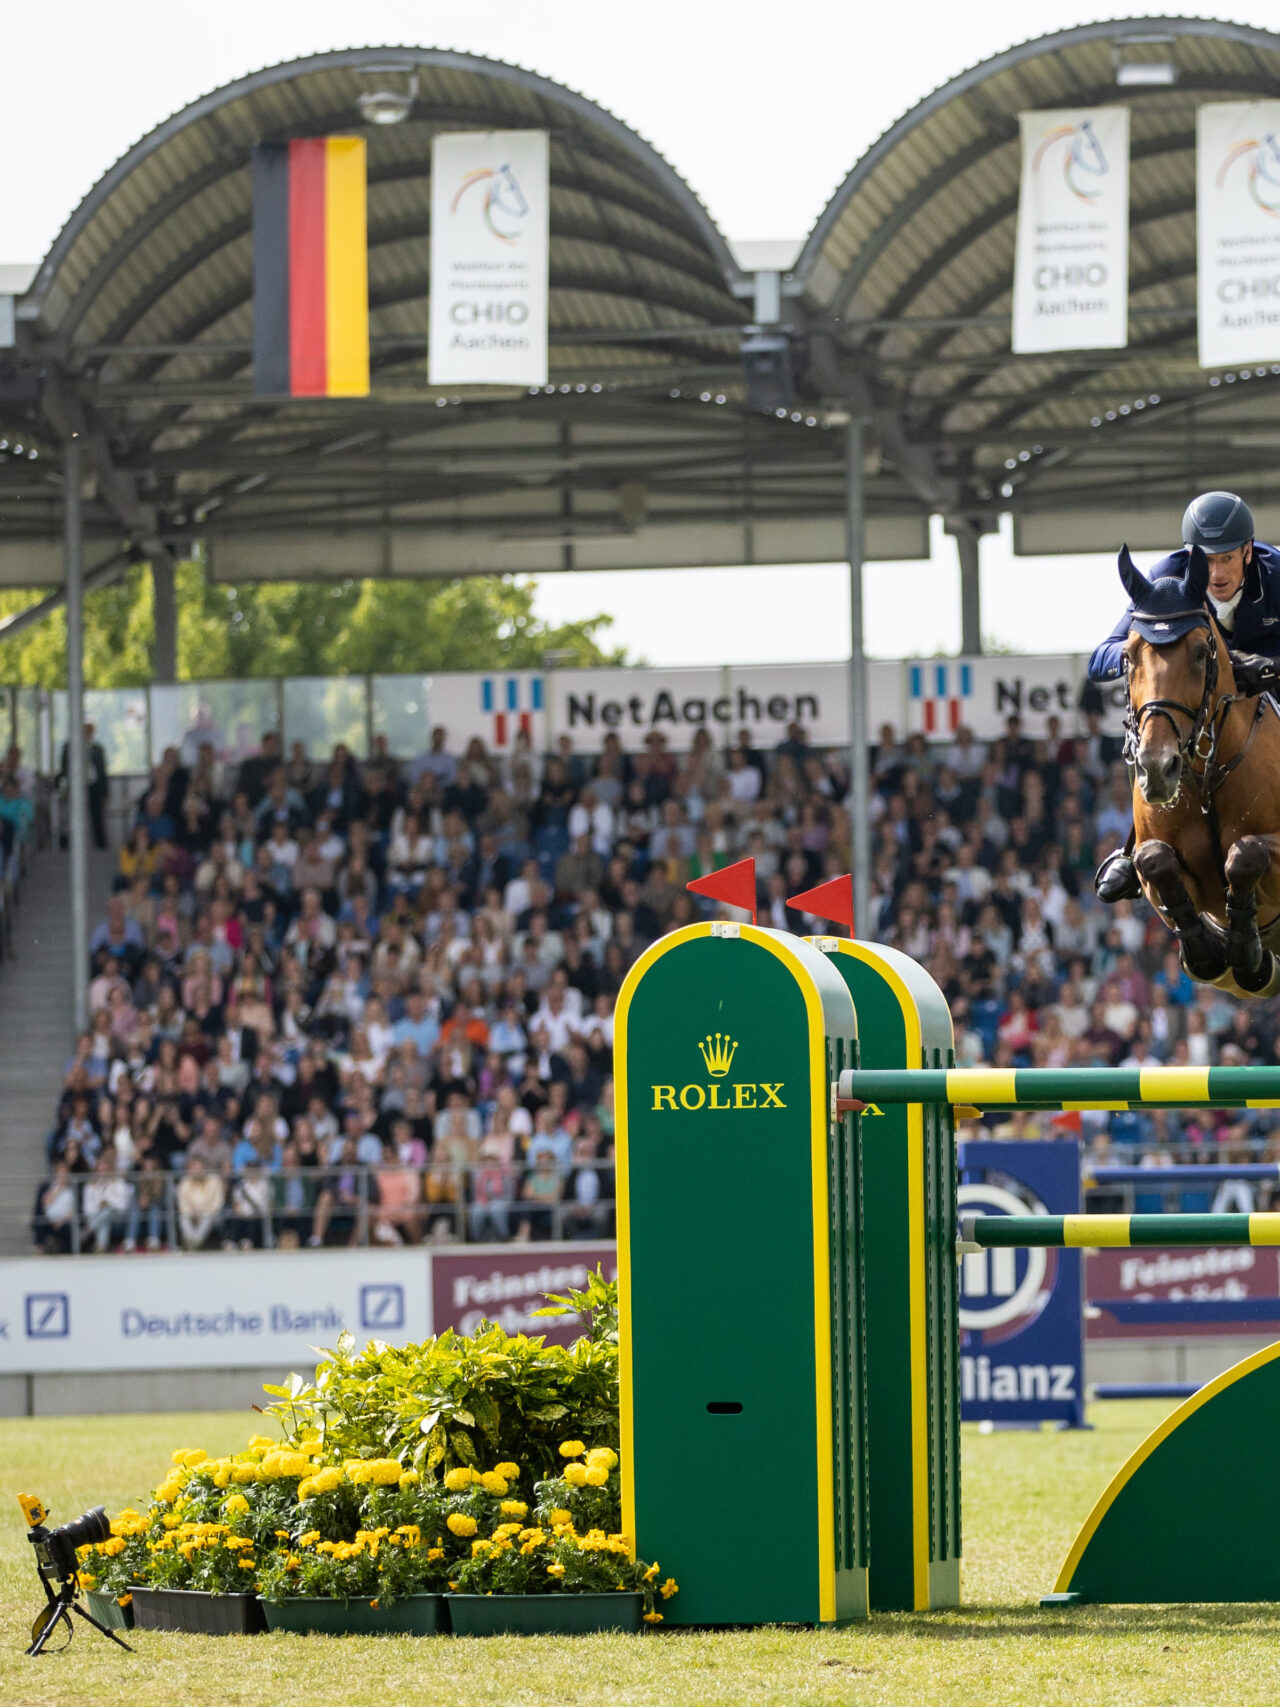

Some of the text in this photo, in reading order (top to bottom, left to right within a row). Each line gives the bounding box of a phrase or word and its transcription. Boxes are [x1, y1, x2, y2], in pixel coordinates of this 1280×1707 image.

[1033, 262, 1109, 292] CHIO
[449, 300, 529, 326] CHIO
[568, 687, 820, 728] NetAachen
[651, 1083, 787, 1111] ROLEX
[453, 1264, 588, 1308] Feinstes
[121, 1304, 345, 1337] Deutsche Bank
[960, 1355, 1076, 1402] lianz
